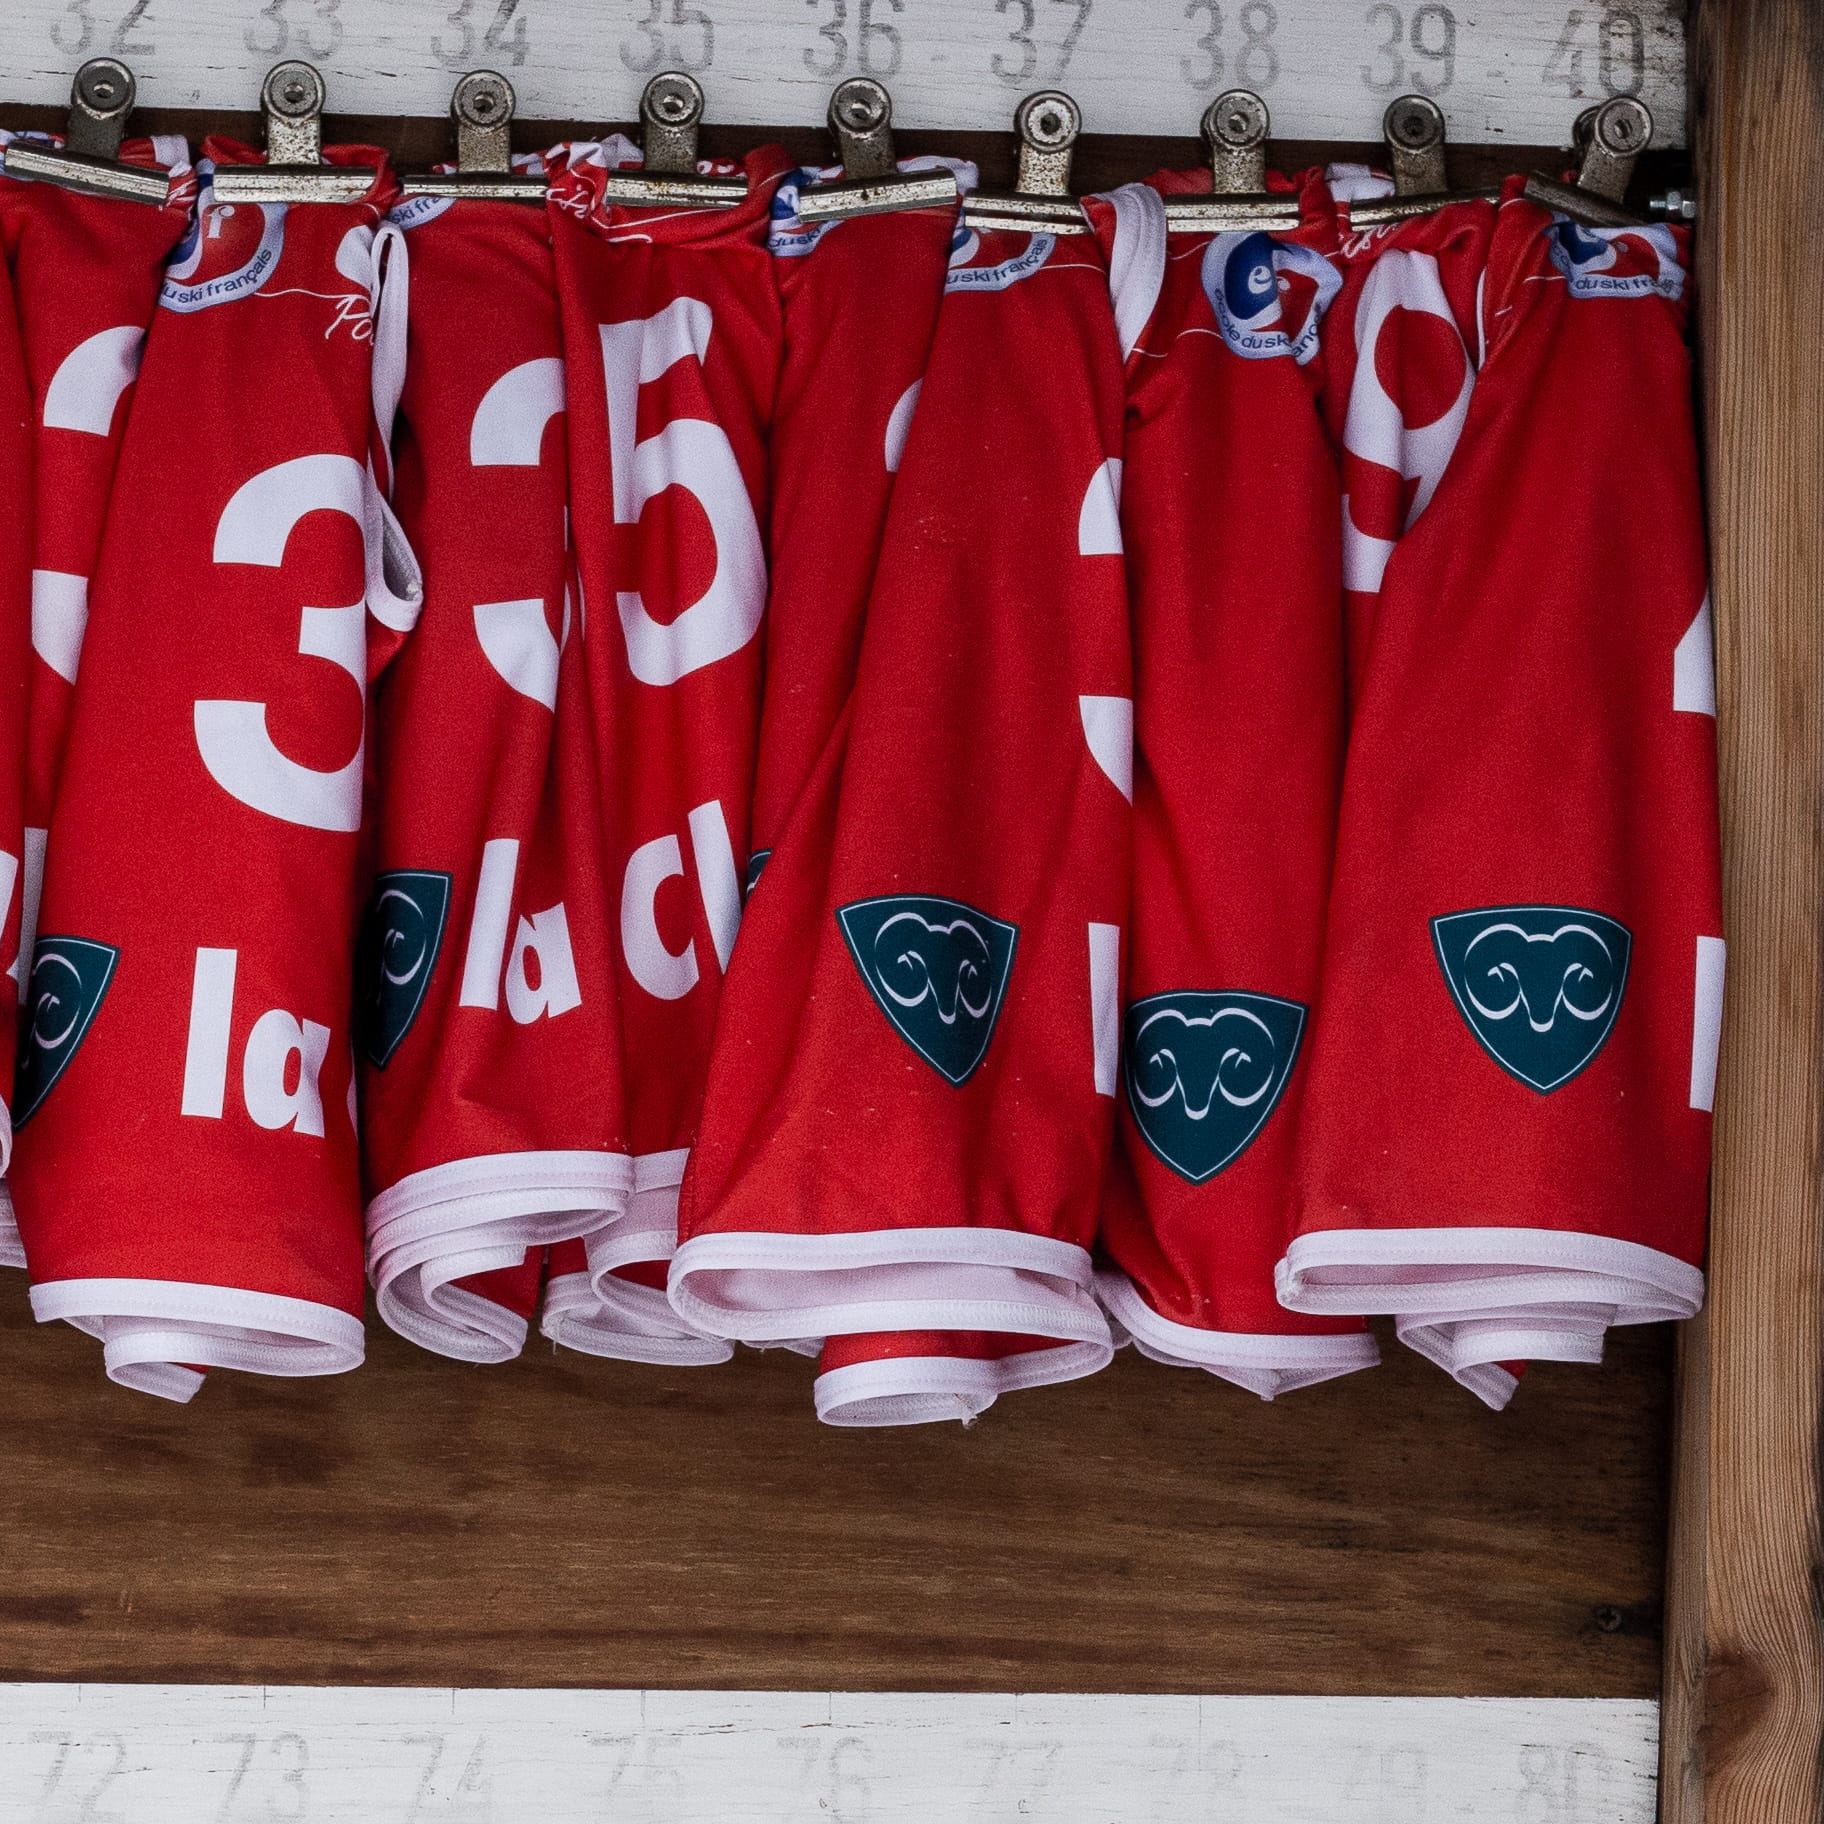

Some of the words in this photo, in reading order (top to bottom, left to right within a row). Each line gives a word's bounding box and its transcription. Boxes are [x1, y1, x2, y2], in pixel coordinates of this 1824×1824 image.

[619, 0, 715, 74] 35
[803, 0, 905, 78] 36
[991, 0, 1093, 84] 37
[1179, 0, 1279, 91] 38
[1360, 2, 1457, 96] 39
[1542, 7, 1644, 99] 40
[205, 247, 272, 298] français
[459, 837, 582, 1026] la
[212, 1732, 311, 1824] 73
